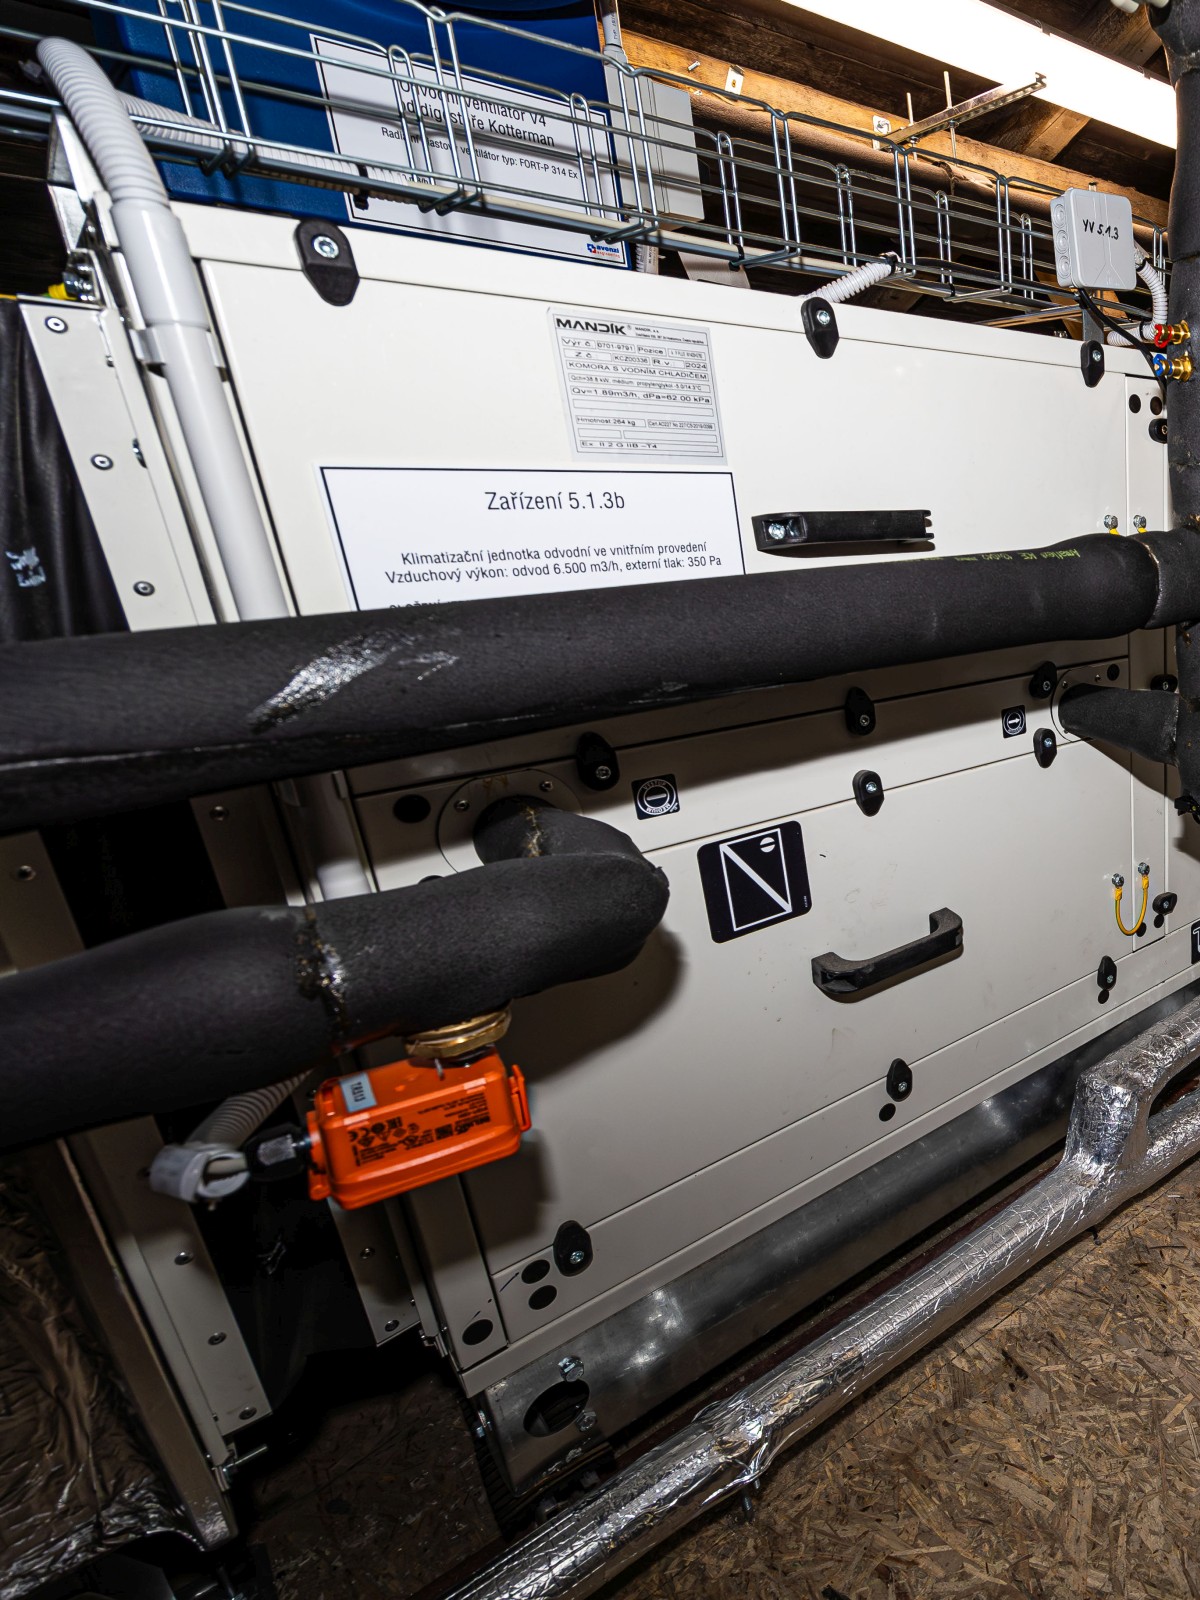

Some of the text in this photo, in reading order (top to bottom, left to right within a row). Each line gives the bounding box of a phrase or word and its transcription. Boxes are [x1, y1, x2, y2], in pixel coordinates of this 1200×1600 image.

[488, 119, 555, 147] Kotterman
[502, 155, 518, 167] typ:
[519, 158, 550, 171] FORT-P
[551, 165, 567, 178] 314
[568, 169, 578, 180] Ex
[1097, 223, 1119, 240] 5.1.3
[556, 317, 627, 336] MANDÍK
[569, 362, 610, 371] KOMORA
[659, 370, 707, 380] CHLADIČEM
[628, 419, 636, 427] kg
[485, 491, 625, 511] Zařízení 5.1.3b
[401, 541, 707, 566] Klimatizační jednotka odvodní ve vnitřním provedení
[385, 555, 722, 584] Vzduchový výkon: odvod 6.500 m3/h, externí tlak: 350 Pa
